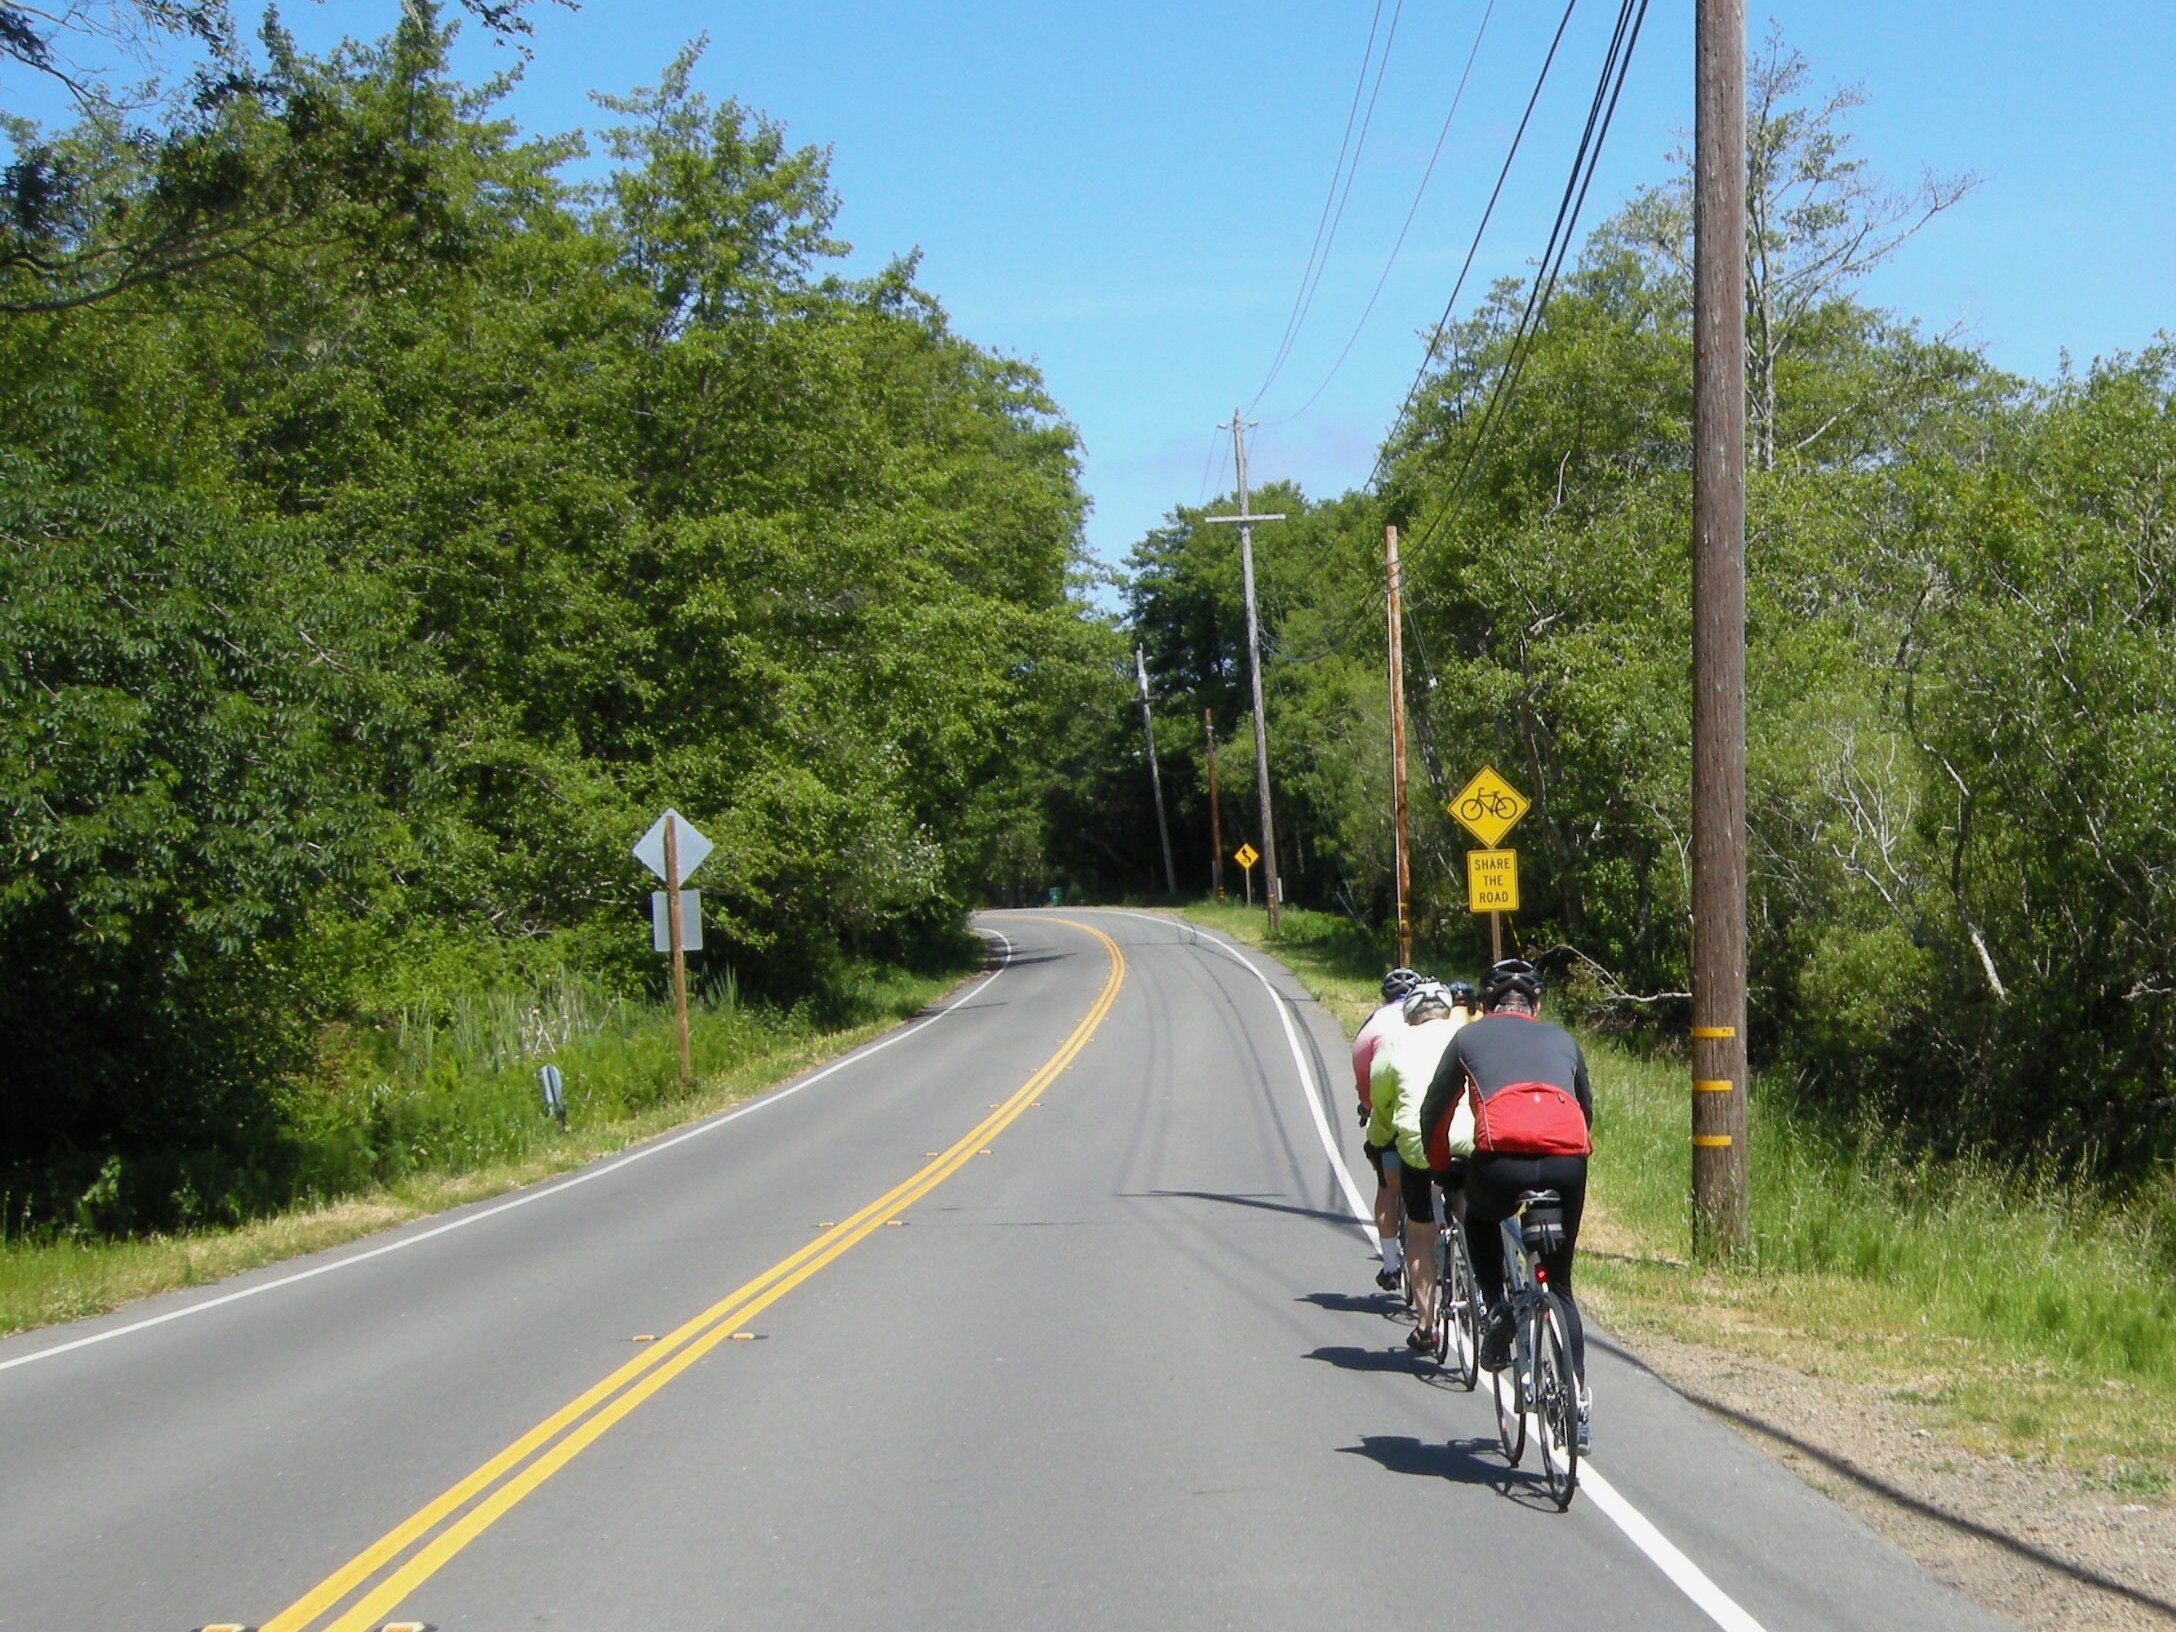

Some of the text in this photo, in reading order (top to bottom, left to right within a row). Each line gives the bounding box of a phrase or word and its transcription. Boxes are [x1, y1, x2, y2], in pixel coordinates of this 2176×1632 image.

[1474, 858, 1511, 871] SHARE
[1483, 875, 1503, 887] THE
[1479, 891, 1509, 903] ROAD
